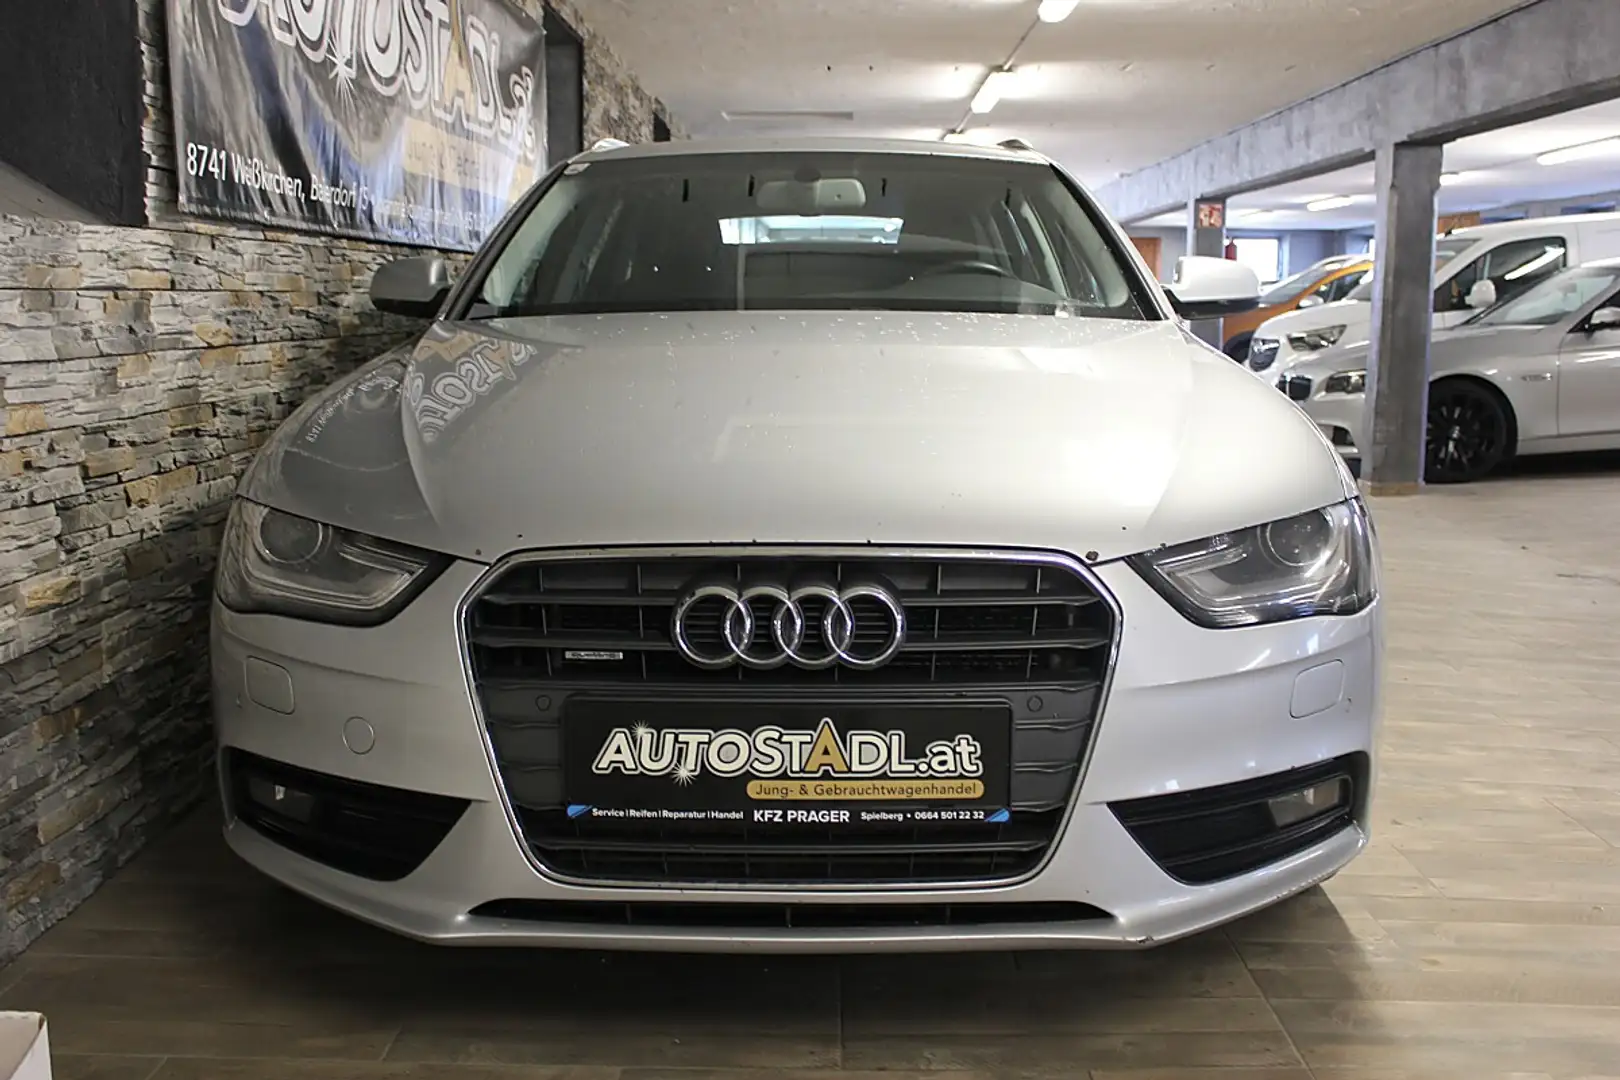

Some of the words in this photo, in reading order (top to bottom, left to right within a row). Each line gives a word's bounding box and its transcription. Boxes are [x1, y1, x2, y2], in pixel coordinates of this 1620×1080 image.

[187, 143, 227, 181] 8741
[592, 717, 984, 778] AUTOSTADL.at
[756, 783, 794, 798] Jung-
[799, 783, 809, 796] &
[813, 782, 977, 798] Gebrauchtwagenhandel
[592, 808, 625, 818] Service
[629, 809, 658, 819] Reifen
[662, 810, 707, 820] Reparatur
[711, 811, 744, 820] Handel
[753, 810, 784, 822] KFZ
[786, 810, 850, 823] PRAGER
[860, 812, 904, 822] Spielberg
[914, 811, 940, 820] 0664
[940, 811, 958, 820] 501
[958, 811, 971, 820] 22
[972, 811, 985, 820] 32
